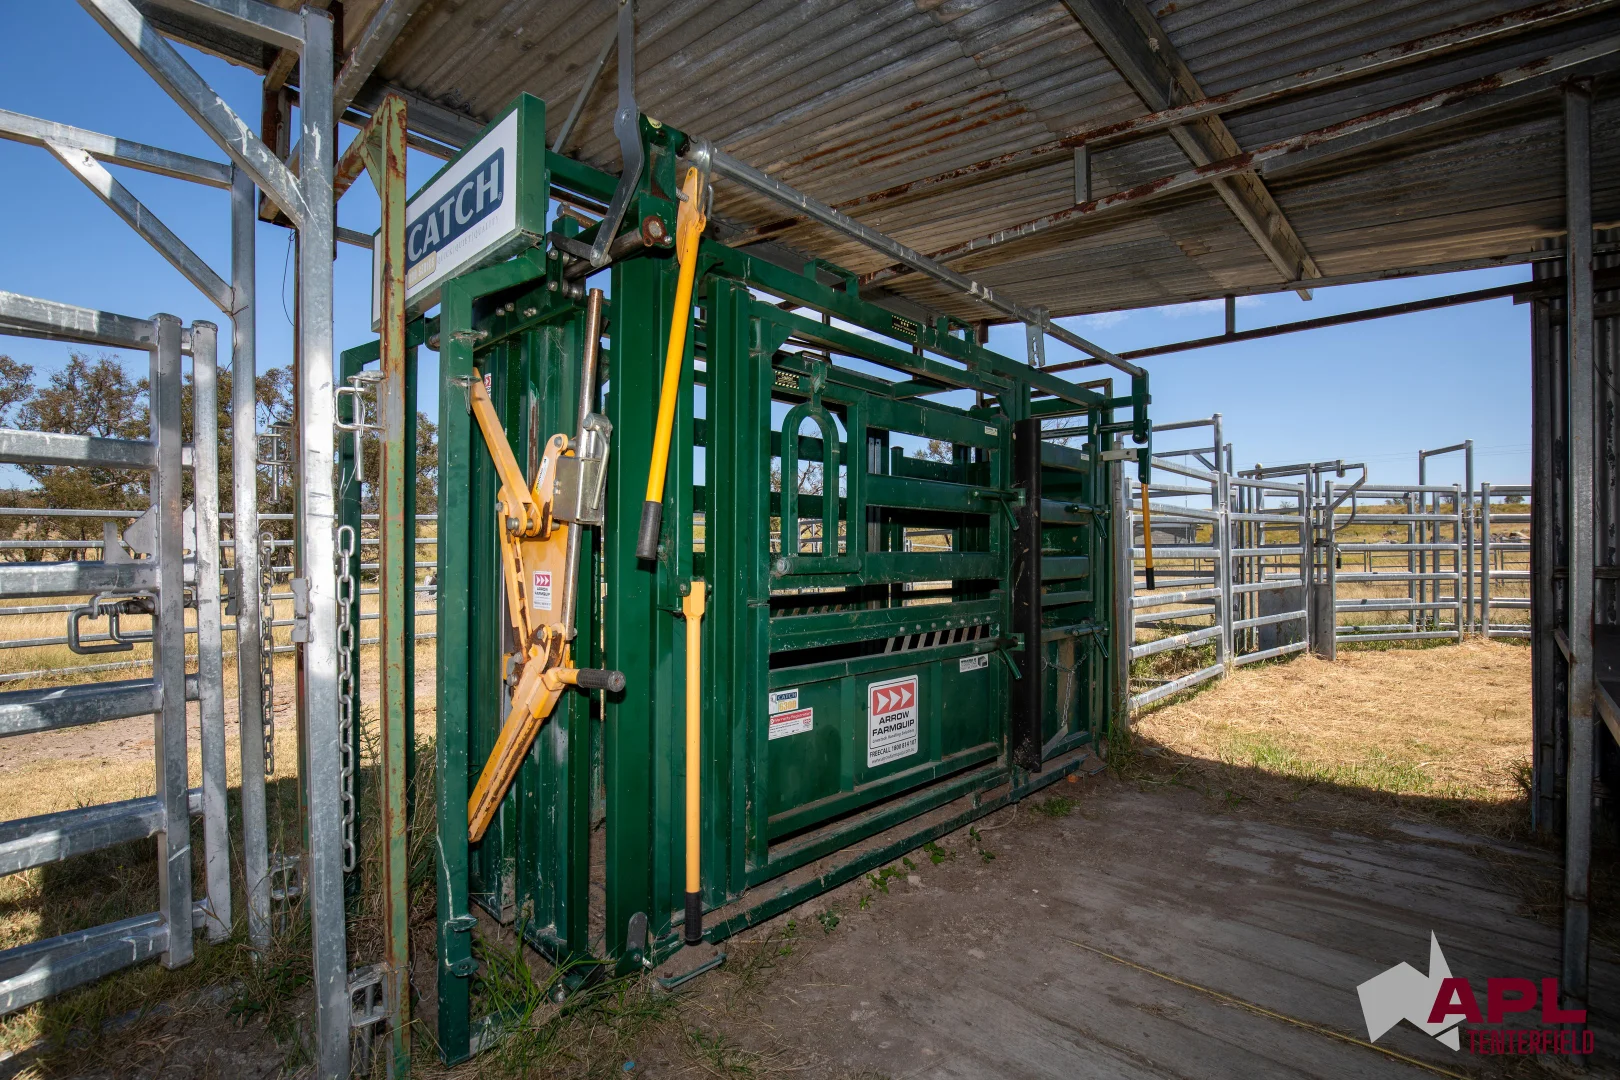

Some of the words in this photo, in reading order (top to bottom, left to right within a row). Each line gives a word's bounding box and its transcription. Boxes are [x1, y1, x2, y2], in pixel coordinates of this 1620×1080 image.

[777, 692, 797, 701] CATCH
[878, 710, 910, 725] ARROW
[872, 719, 915, 737] FARMQUIP
[869, 747, 891, 758] FREECALL
